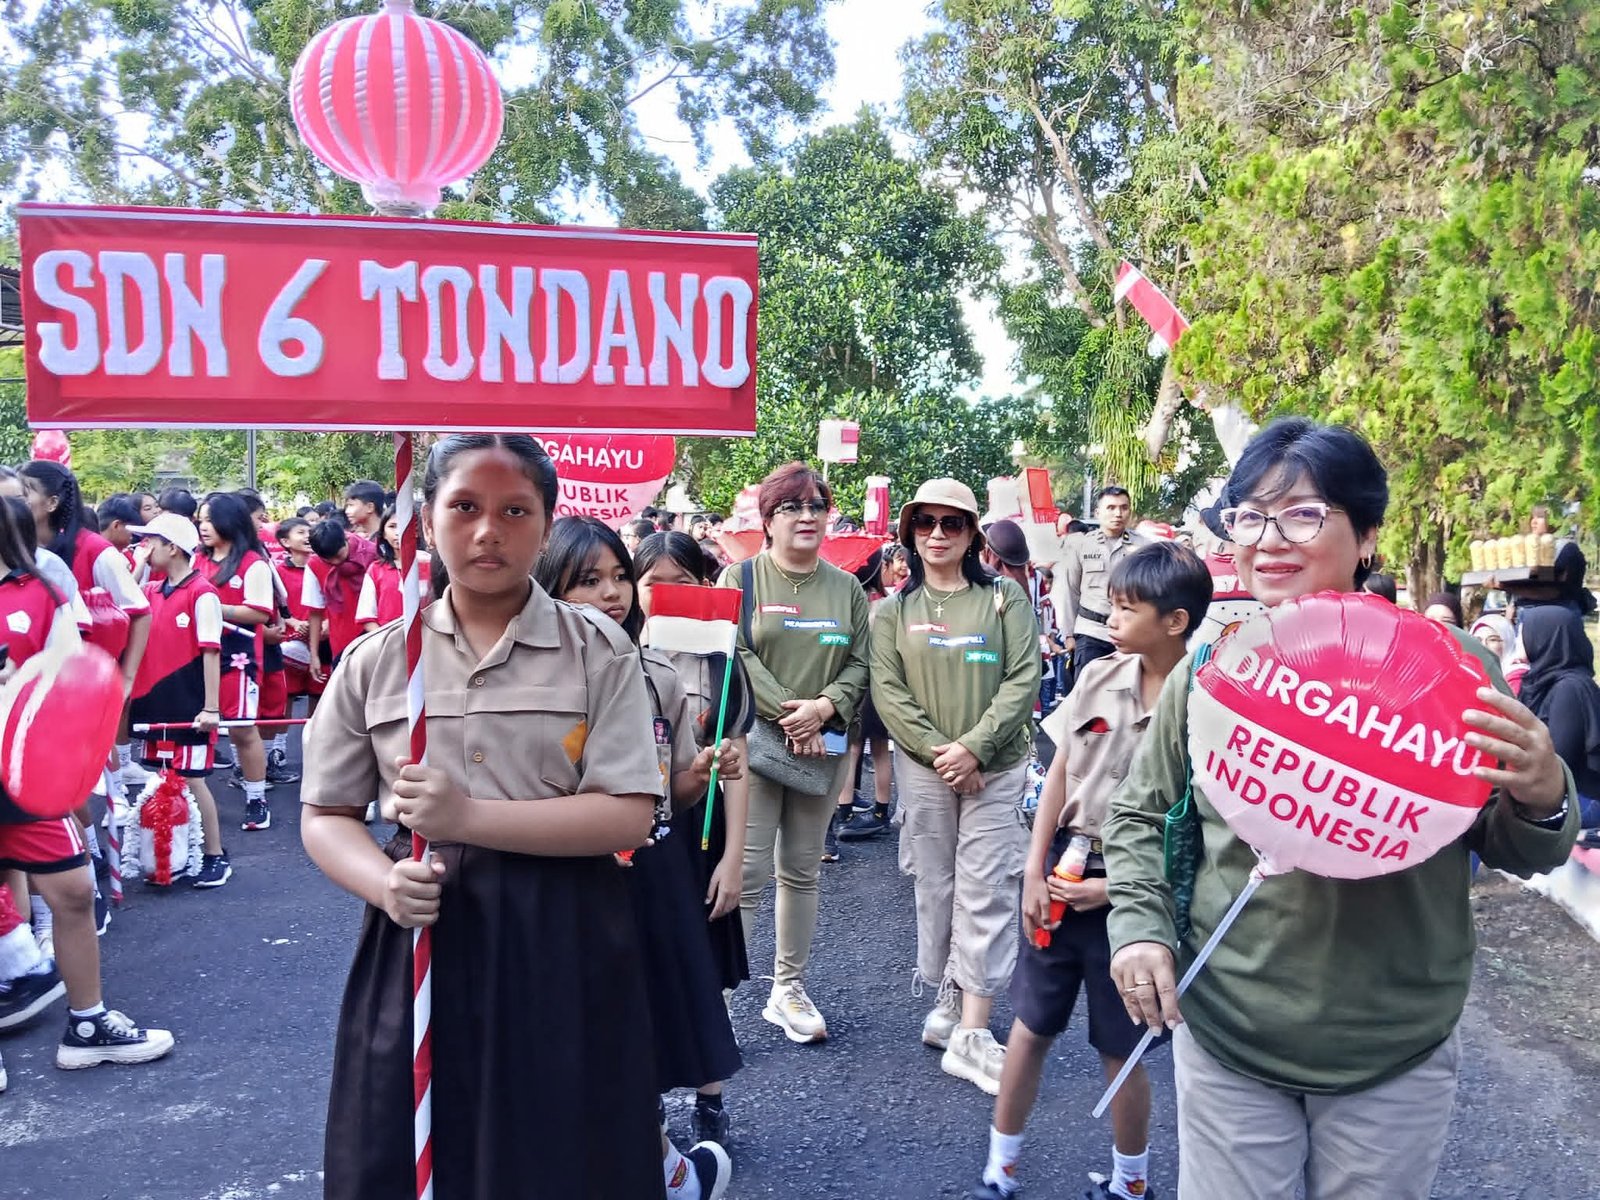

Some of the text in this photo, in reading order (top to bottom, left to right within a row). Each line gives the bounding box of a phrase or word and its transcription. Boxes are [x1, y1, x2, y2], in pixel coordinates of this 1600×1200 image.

[33, 250, 753, 389] SDN 6 TONDANO
[556, 504, 632, 520] ONESIA
[557, 484, 629, 503] UBLIK
[1226, 649, 1482, 776] DIRGAHAYU
[1206, 750, 1411, 861] INDONESIA
[1226, 725, 1430, 835] REPUBLIK
